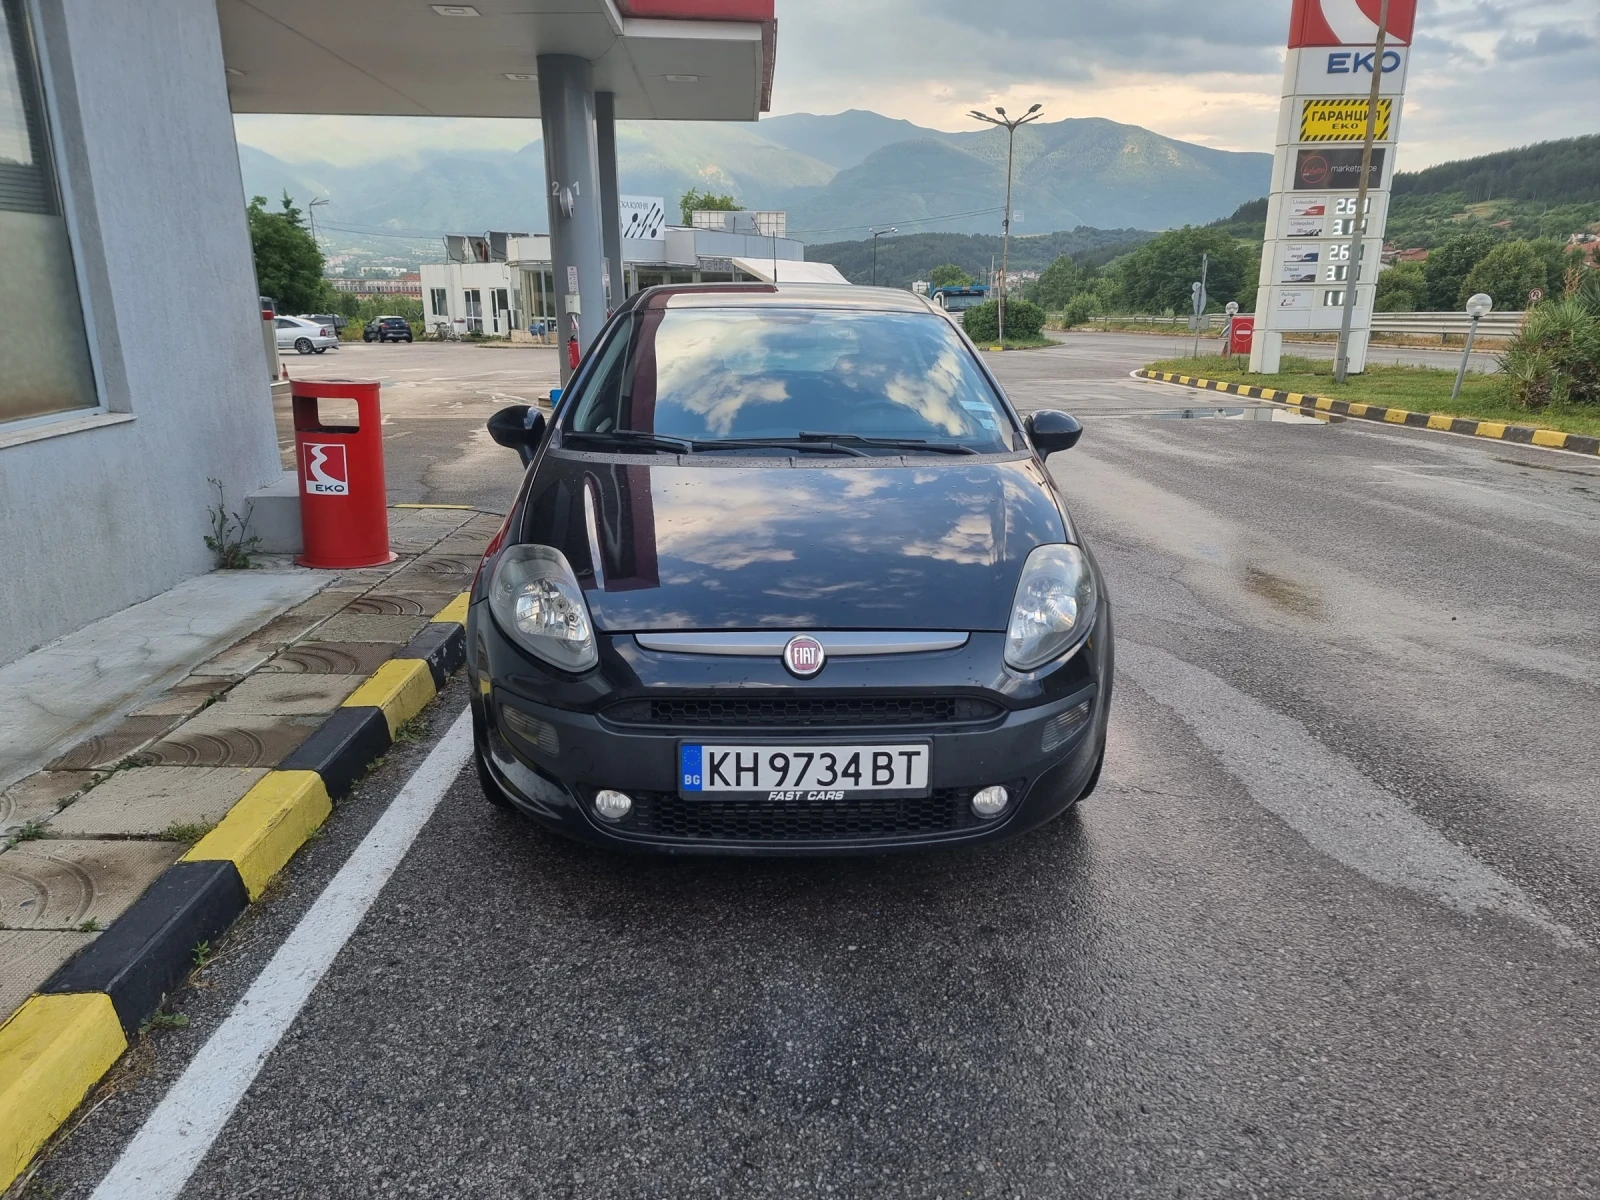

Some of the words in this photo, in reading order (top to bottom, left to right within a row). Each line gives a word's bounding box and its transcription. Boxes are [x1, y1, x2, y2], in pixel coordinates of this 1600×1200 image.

[1327, 51, 1401, 74] EKO
[1330, 164, 1378, 174] marketpce
[552, 181, 560, 195] 2
[572, 181, 580, 195] 1
[315, 484, 345, 492] EKO
[794, 647, 816, 665] FIAT
[769, 752, 862, 787] 9734
[684, 774, 701, 785] BG
[768, 791, 804, 801] FAST
[807, 790, 845, 801] CARS
